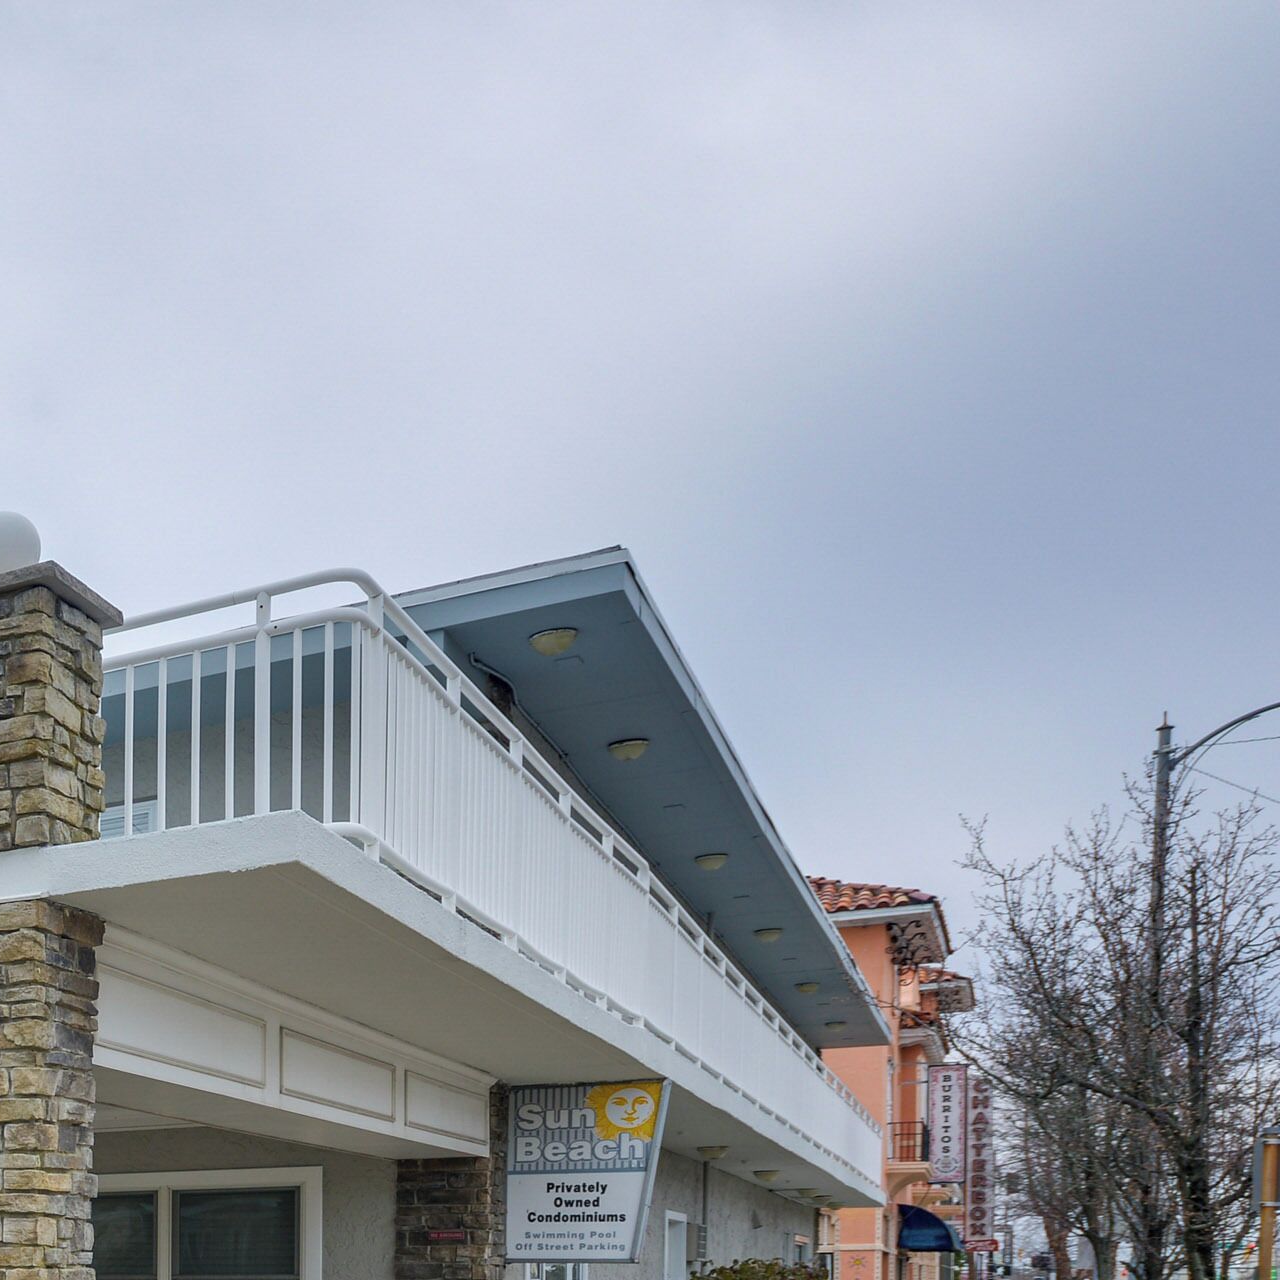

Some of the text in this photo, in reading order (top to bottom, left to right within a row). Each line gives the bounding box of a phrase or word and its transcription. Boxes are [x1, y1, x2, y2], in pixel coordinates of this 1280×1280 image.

[516, 1103, 595, 1131] Sun
[941, 1074, 952, 1154] BURRITOS
[515, 1133, 644, 1163] Beach
[970, 1078, 989, 1236] CHATTERBOX
[546, 1182, 608, 1195] Privately
[554, 1197, 600, 1208] Owned
[527, 1211, 626, 1223] Condominiums
[525, 1231, 616, 1239] Swimming Pool
[515, 1243, 532, 1251] Off
[579, 1243, 626, 1251] Parking
